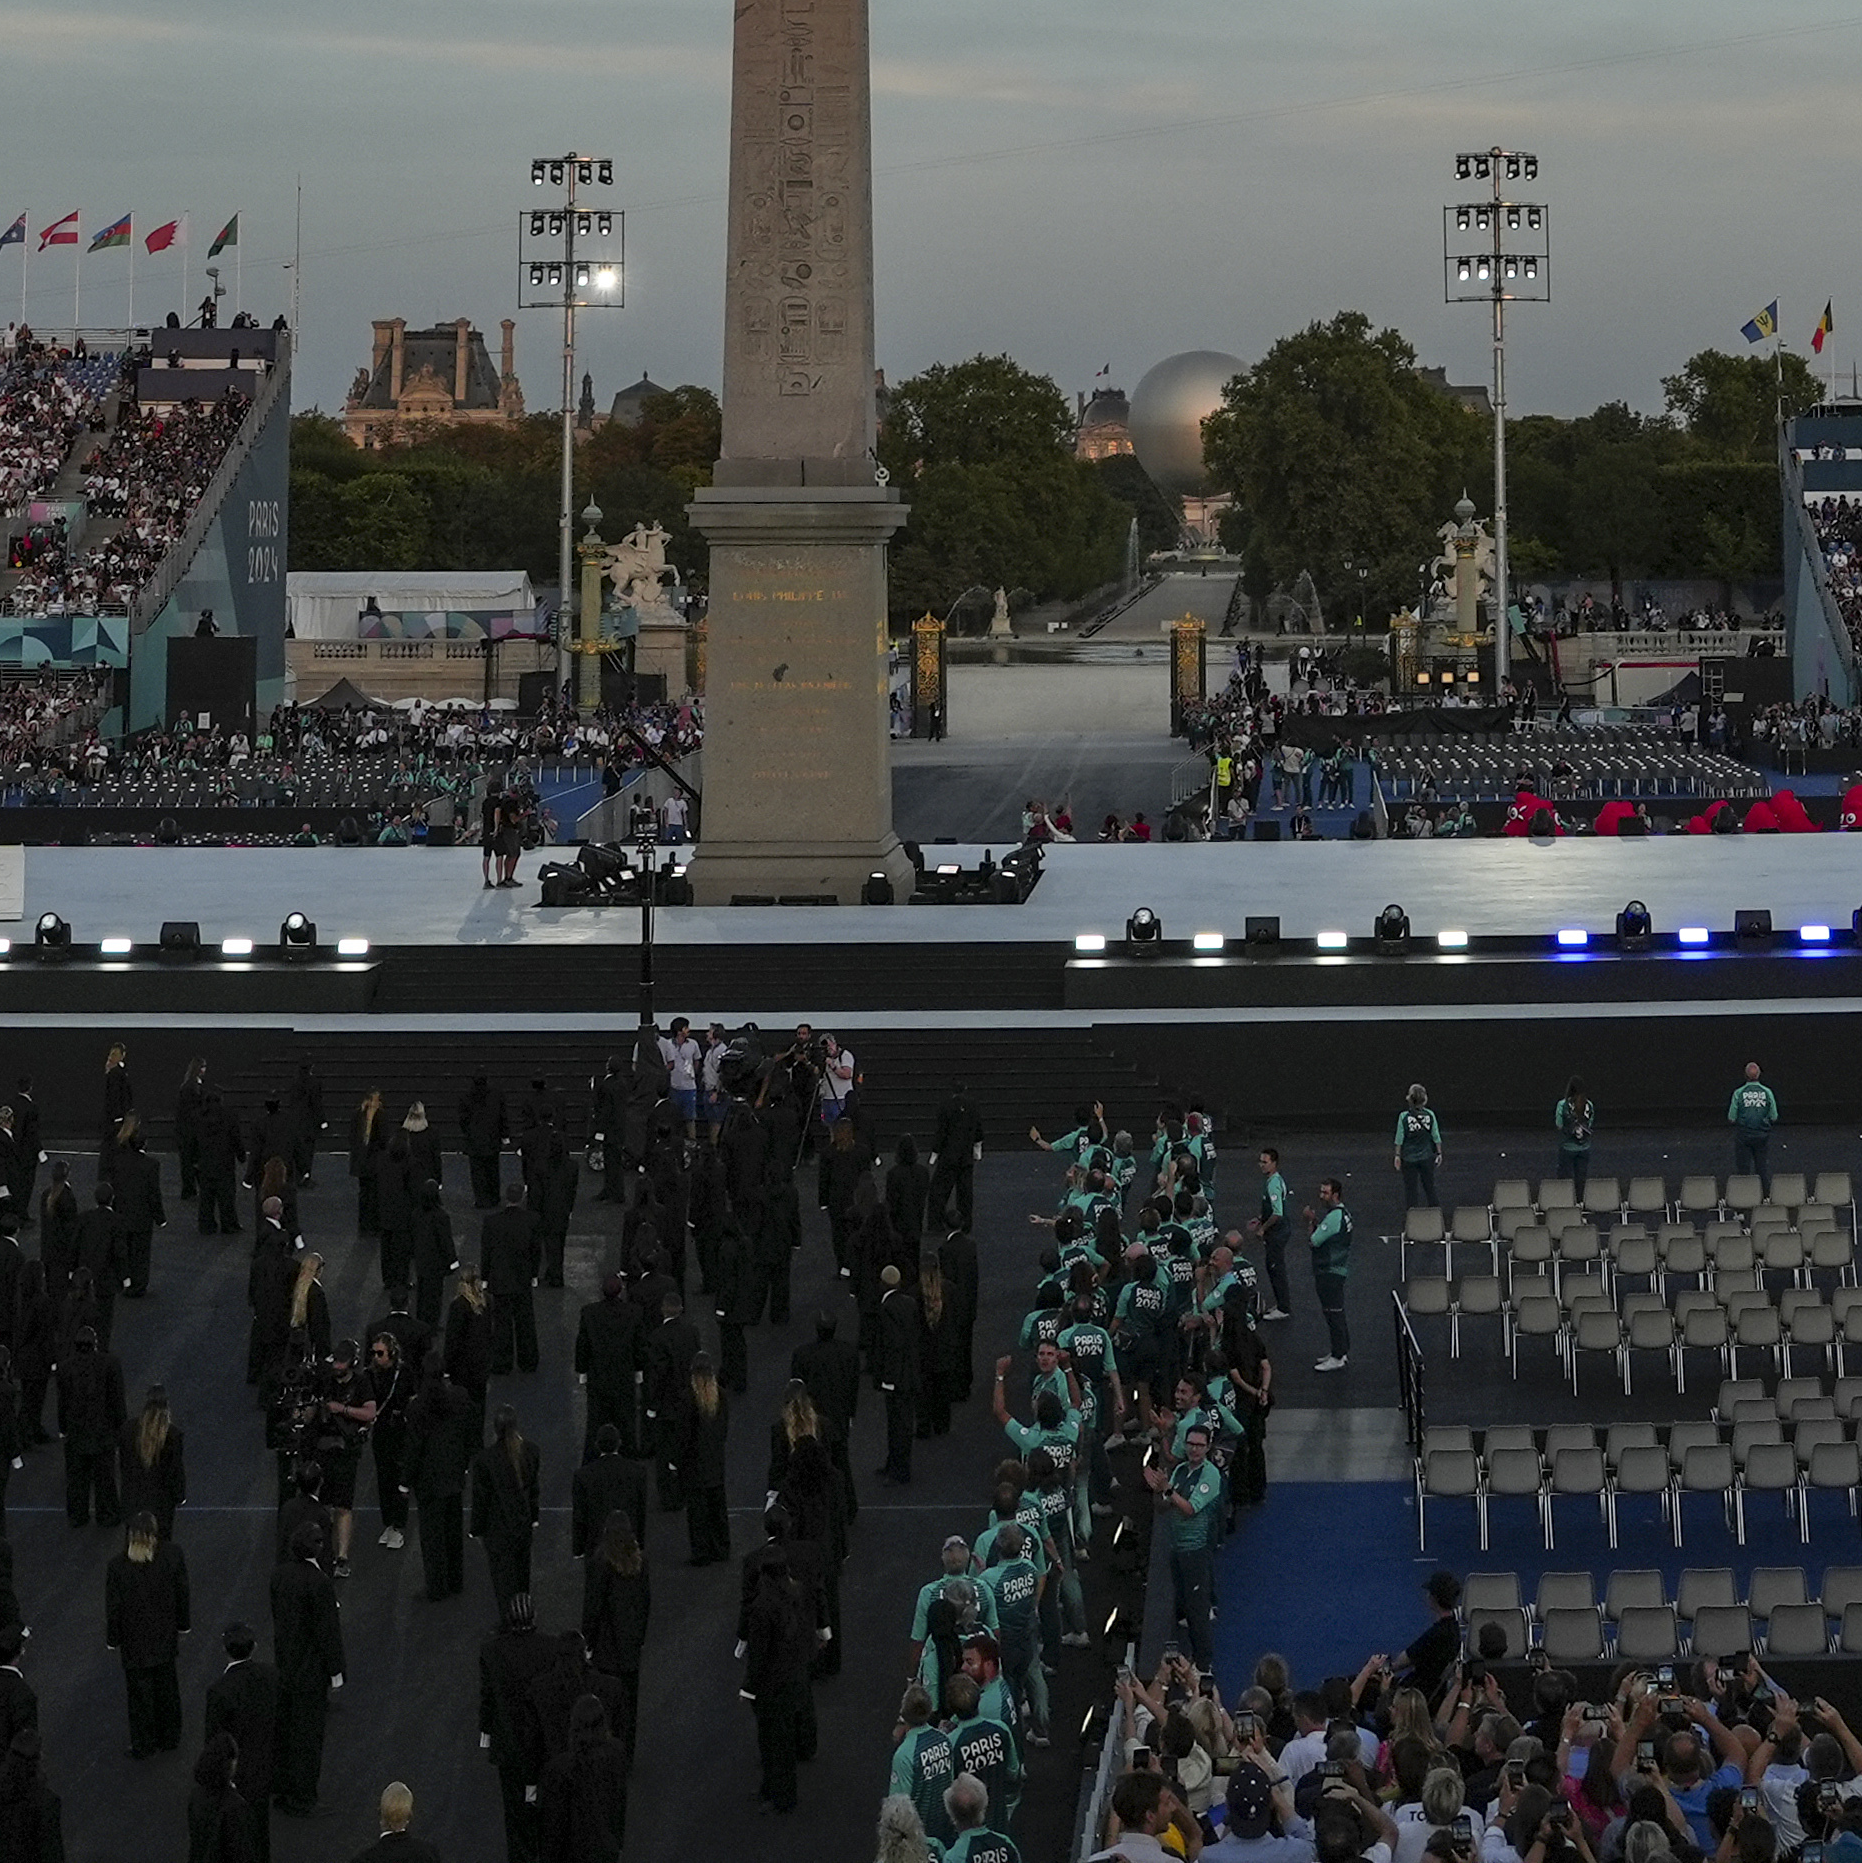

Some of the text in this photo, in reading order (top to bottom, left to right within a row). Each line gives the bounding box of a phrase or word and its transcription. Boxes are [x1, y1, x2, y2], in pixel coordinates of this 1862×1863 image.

[248, 500, 279, 537] PARIS
[248, 546, 278, 584] 2024
[1074, 1334, 1103, 1348] PARIS
[1075, 1345, 1103, 1358] 2024
[1003, 1573, 1035, 1595] PARIS
[920, 1741, 951, 1767] PARIS
[960, 1732, 1003, 1762] PARIS
[923, 1757, 952, 1781] 2024
[965, 1749, 1005, 1774] 2024
